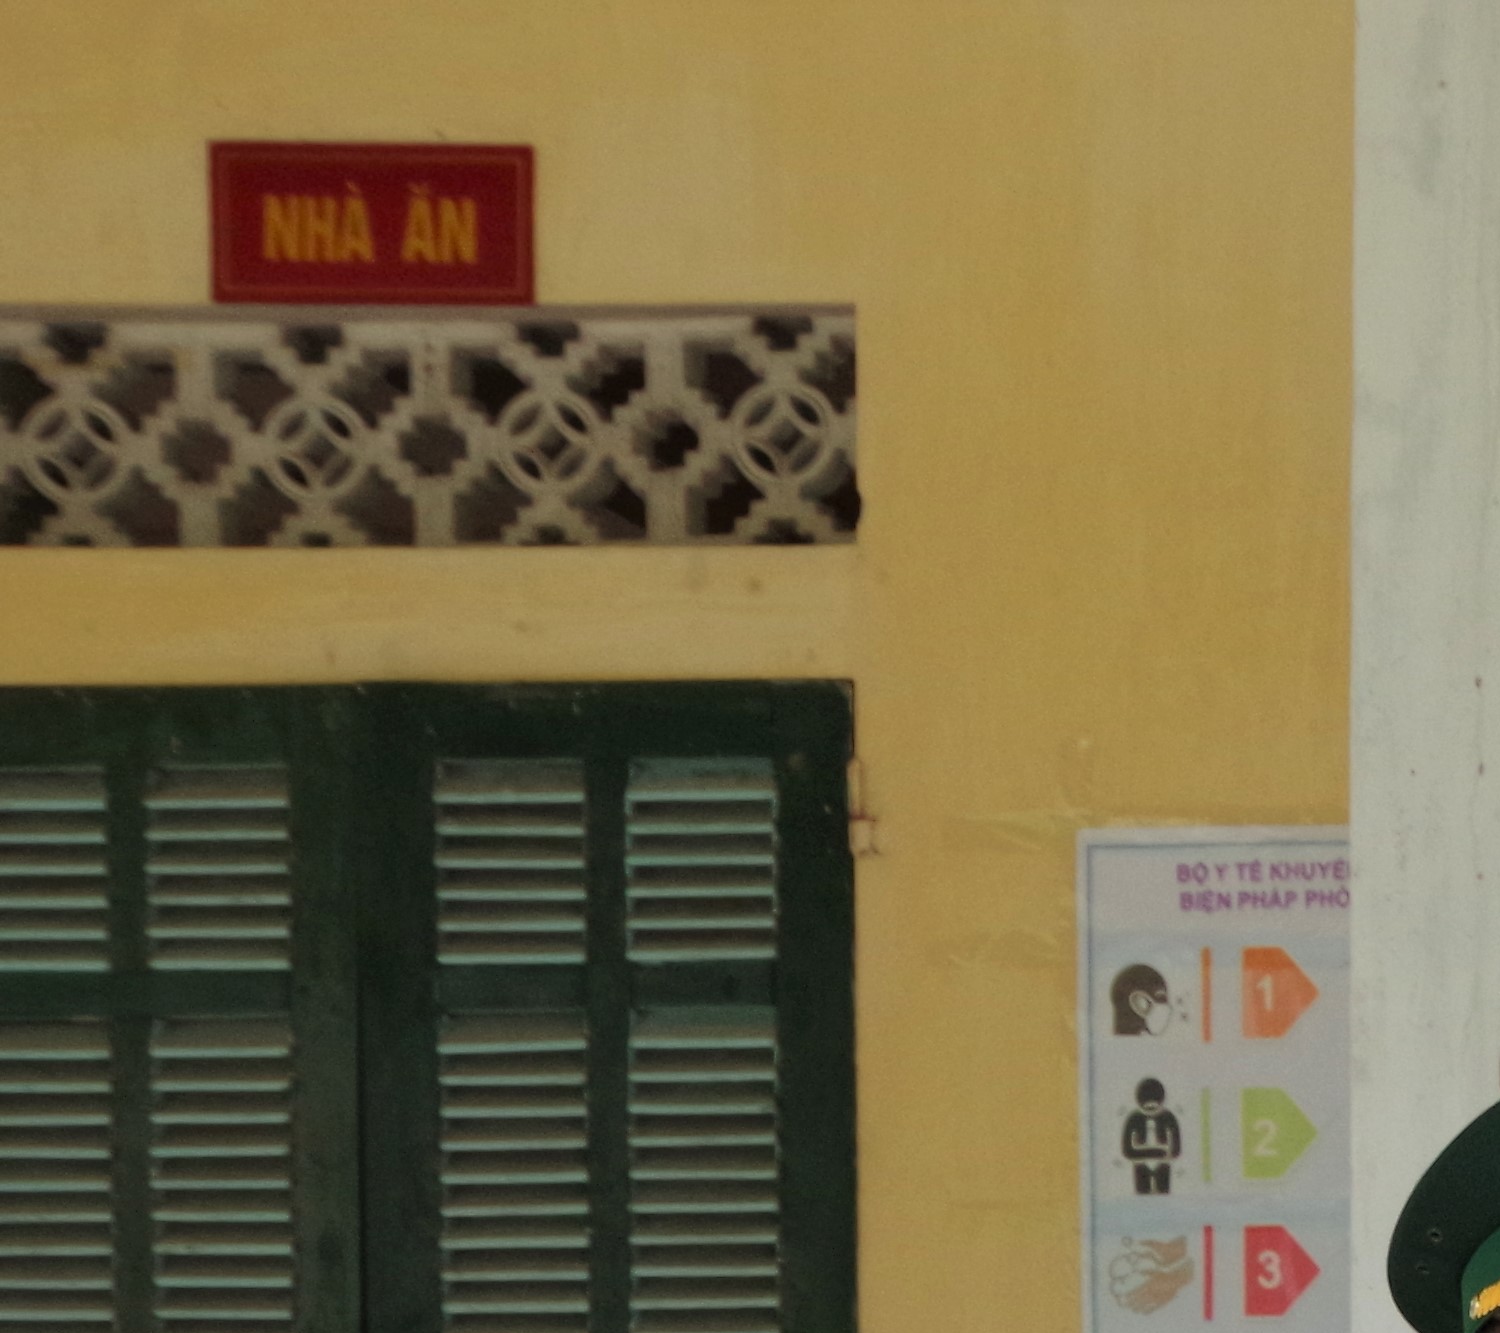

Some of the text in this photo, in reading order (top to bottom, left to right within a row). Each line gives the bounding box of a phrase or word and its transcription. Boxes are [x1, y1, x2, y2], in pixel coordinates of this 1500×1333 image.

[263, 179, 375, 263] NHÀ
[1215, 864, 1228, 881] Y
[1256, 975, 1274, 1012] 1
[1254, 1119, 1278, 1156] 2
[1257, 1250, 1282, 1290] 3
